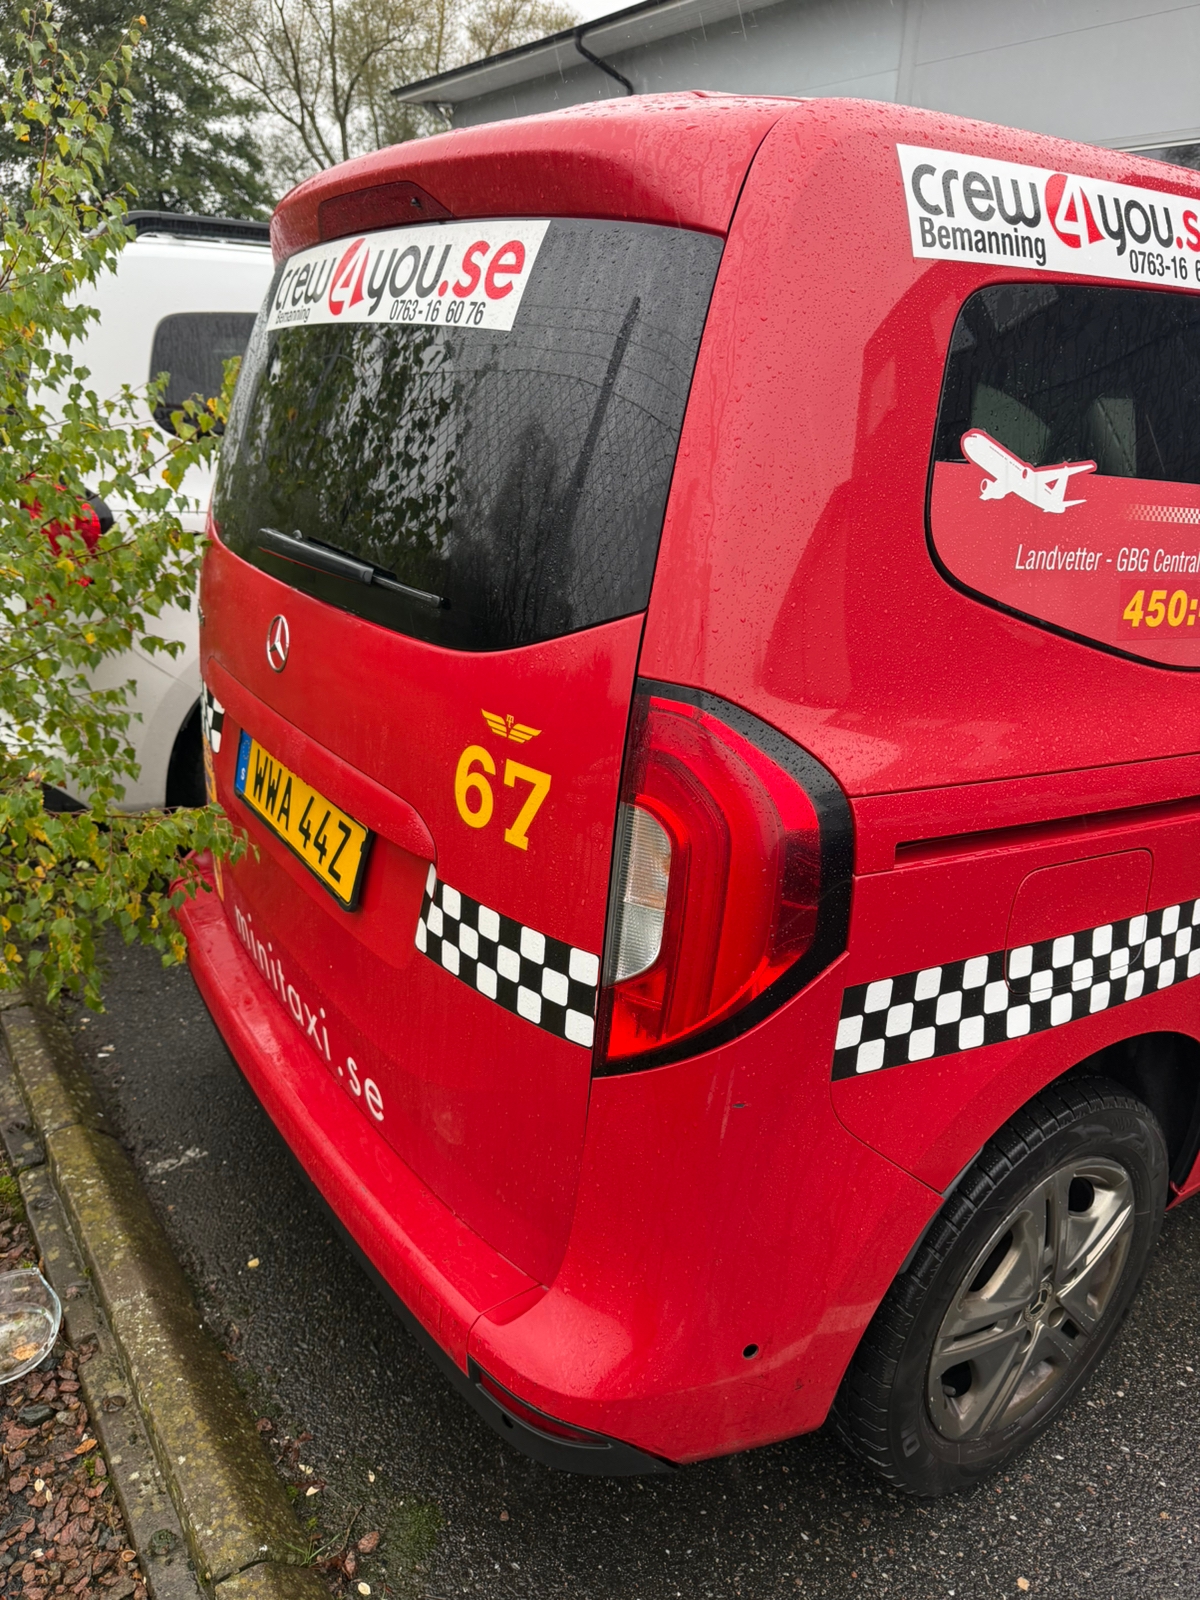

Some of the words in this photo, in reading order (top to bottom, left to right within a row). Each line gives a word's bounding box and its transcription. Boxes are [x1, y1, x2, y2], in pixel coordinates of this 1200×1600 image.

[918, 216, 1047, 267] Bemanning
[275, 238, 526, 317] crew4you.se
[1129, 249, 1188, 281] 0763-16
[389, 299, 442, 322] 0763-16
[445, 300, 465, 324] 60
[465, 301, 487, 326] 76
[1015, 543, 1103, 571] Landvetter
[1116, 547, 1150, 572] GBG
[1122, 589, 1200, 628] 450:
[240, 767, 246, 781] S
[253, 748, 293, 832] WWA
[298, 796, 352, 884] 44Z
[454, 744, 552, 851] 67
